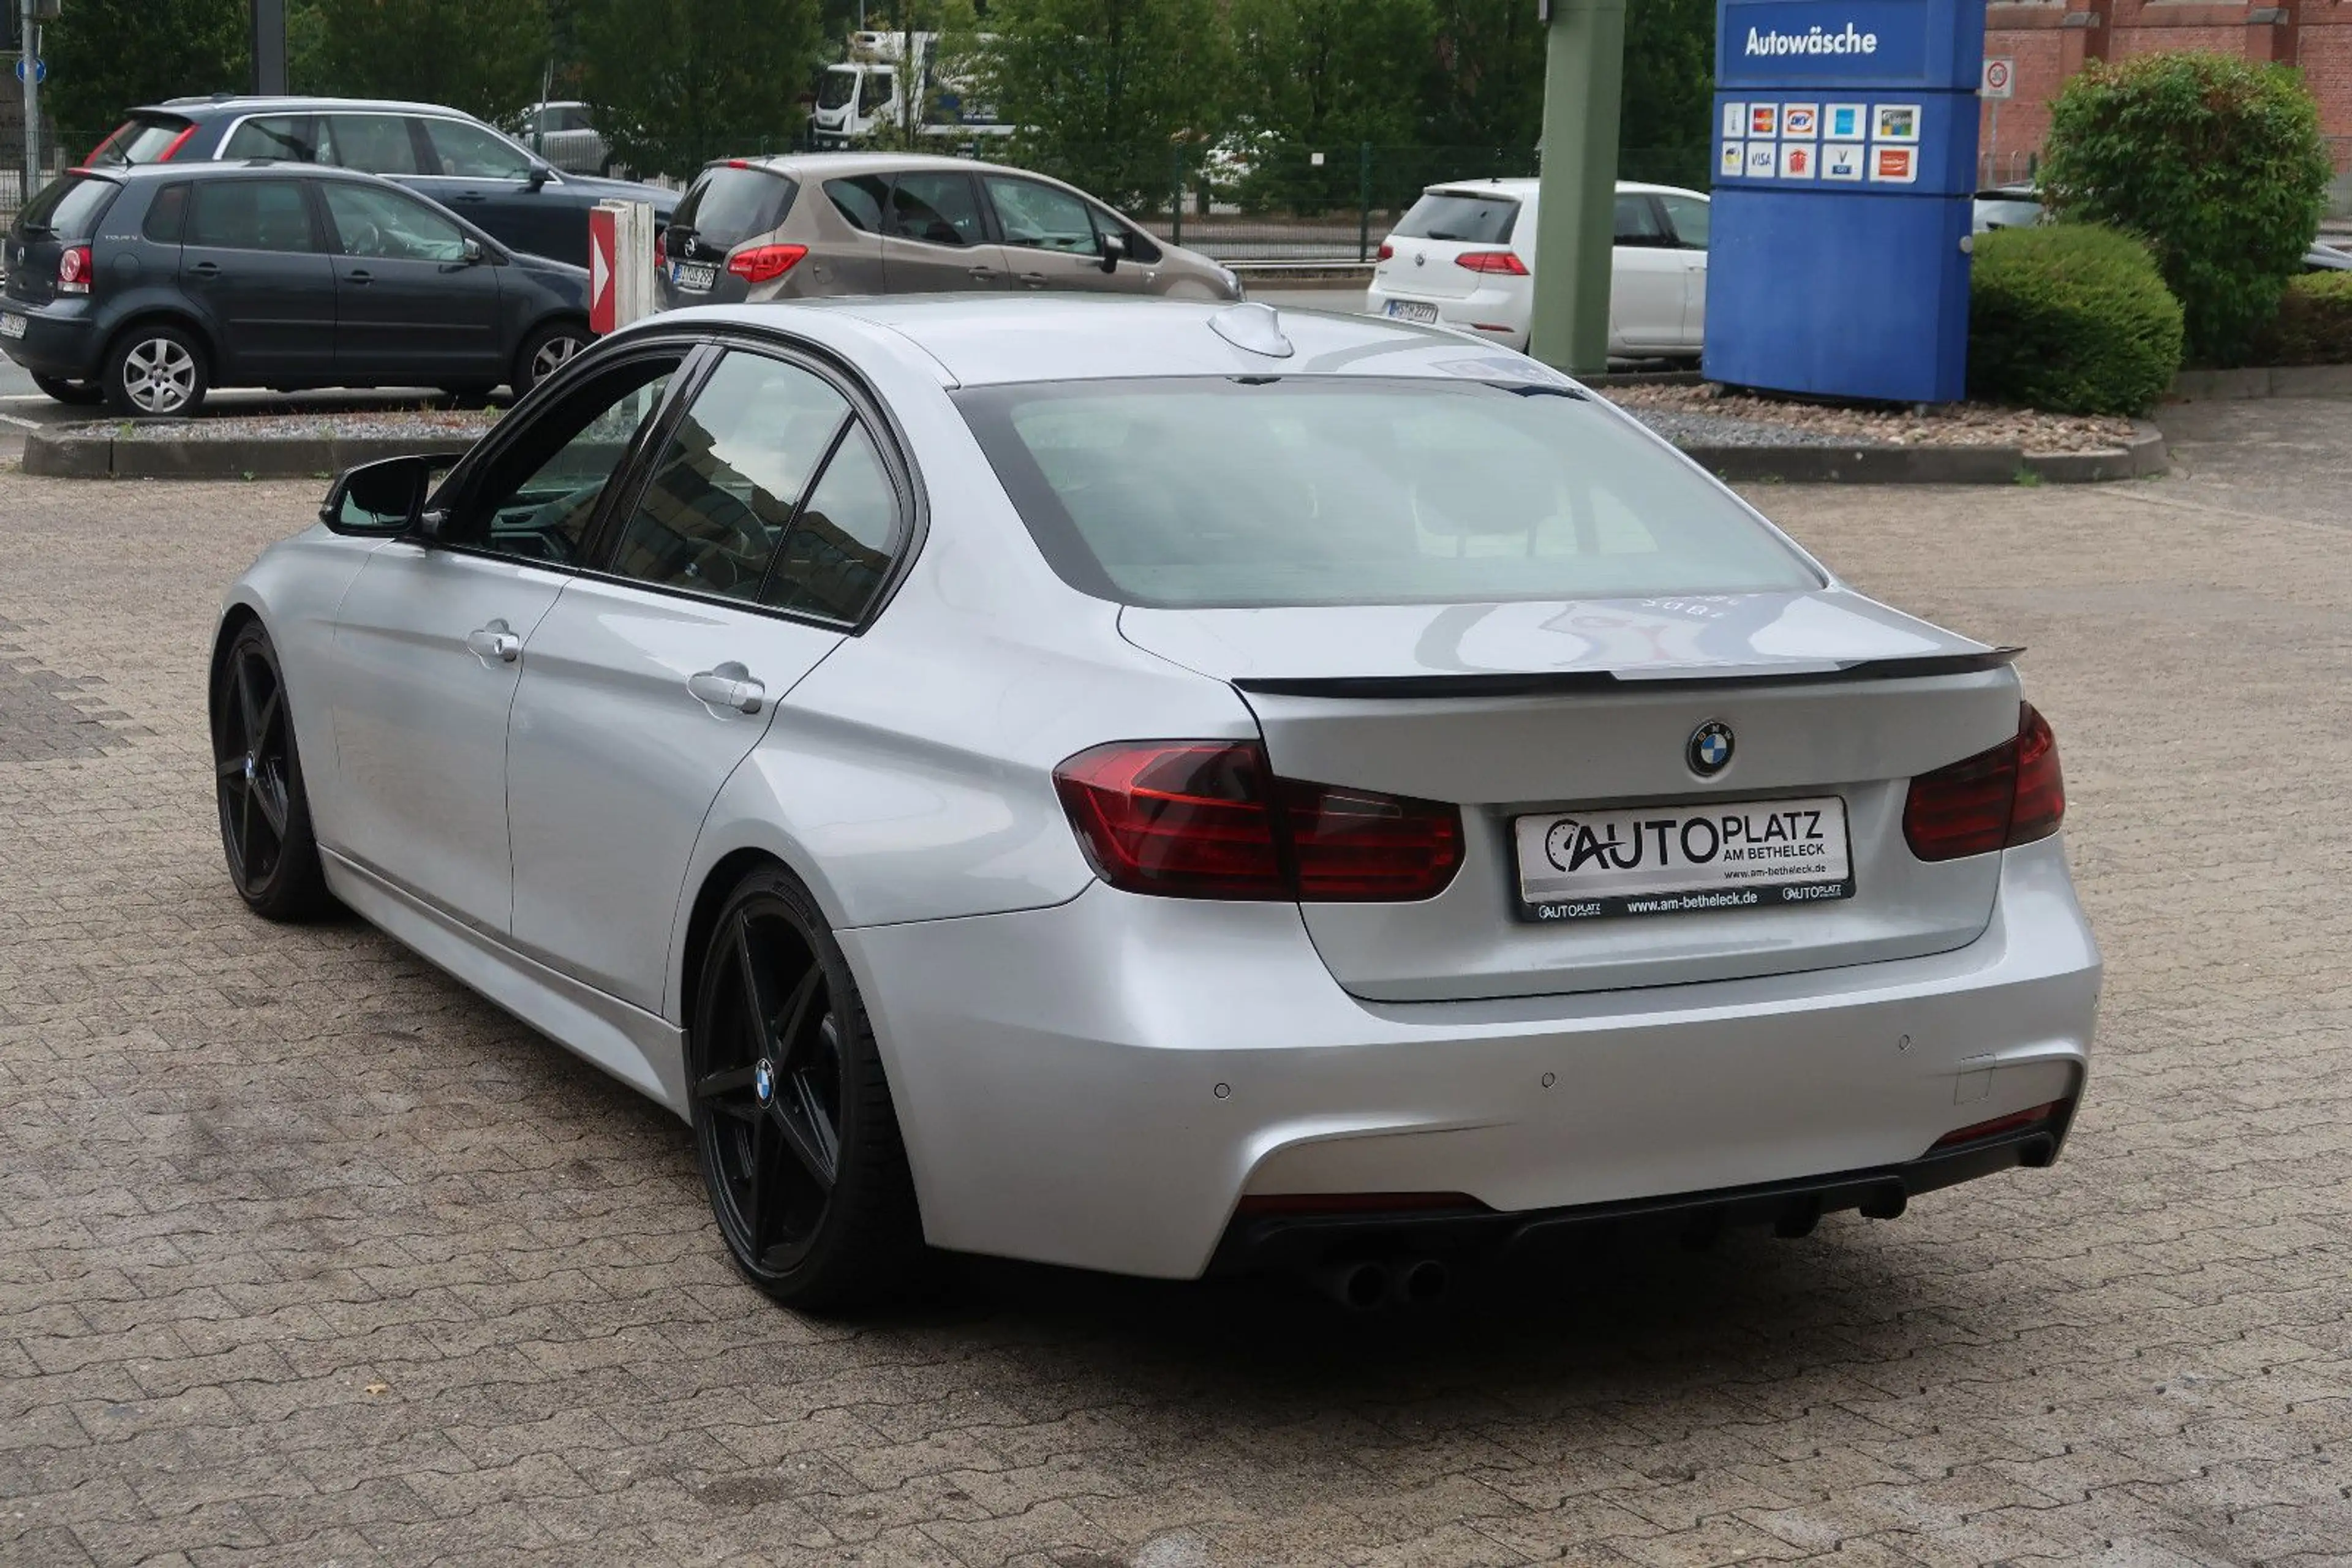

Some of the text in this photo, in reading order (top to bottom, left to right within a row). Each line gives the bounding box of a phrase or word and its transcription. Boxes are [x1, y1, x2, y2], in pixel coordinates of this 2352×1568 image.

[1745, 22, 1877, 56] Autowäsche
[1752, 152, 1771, 166] VISA
[1723, 843, 1825, 862] AM BETHELECK
[1724, 864, 1826, 878] www.am-betheleck.de
[1627, 891, 1757, 912] www.am-betheleck.de
